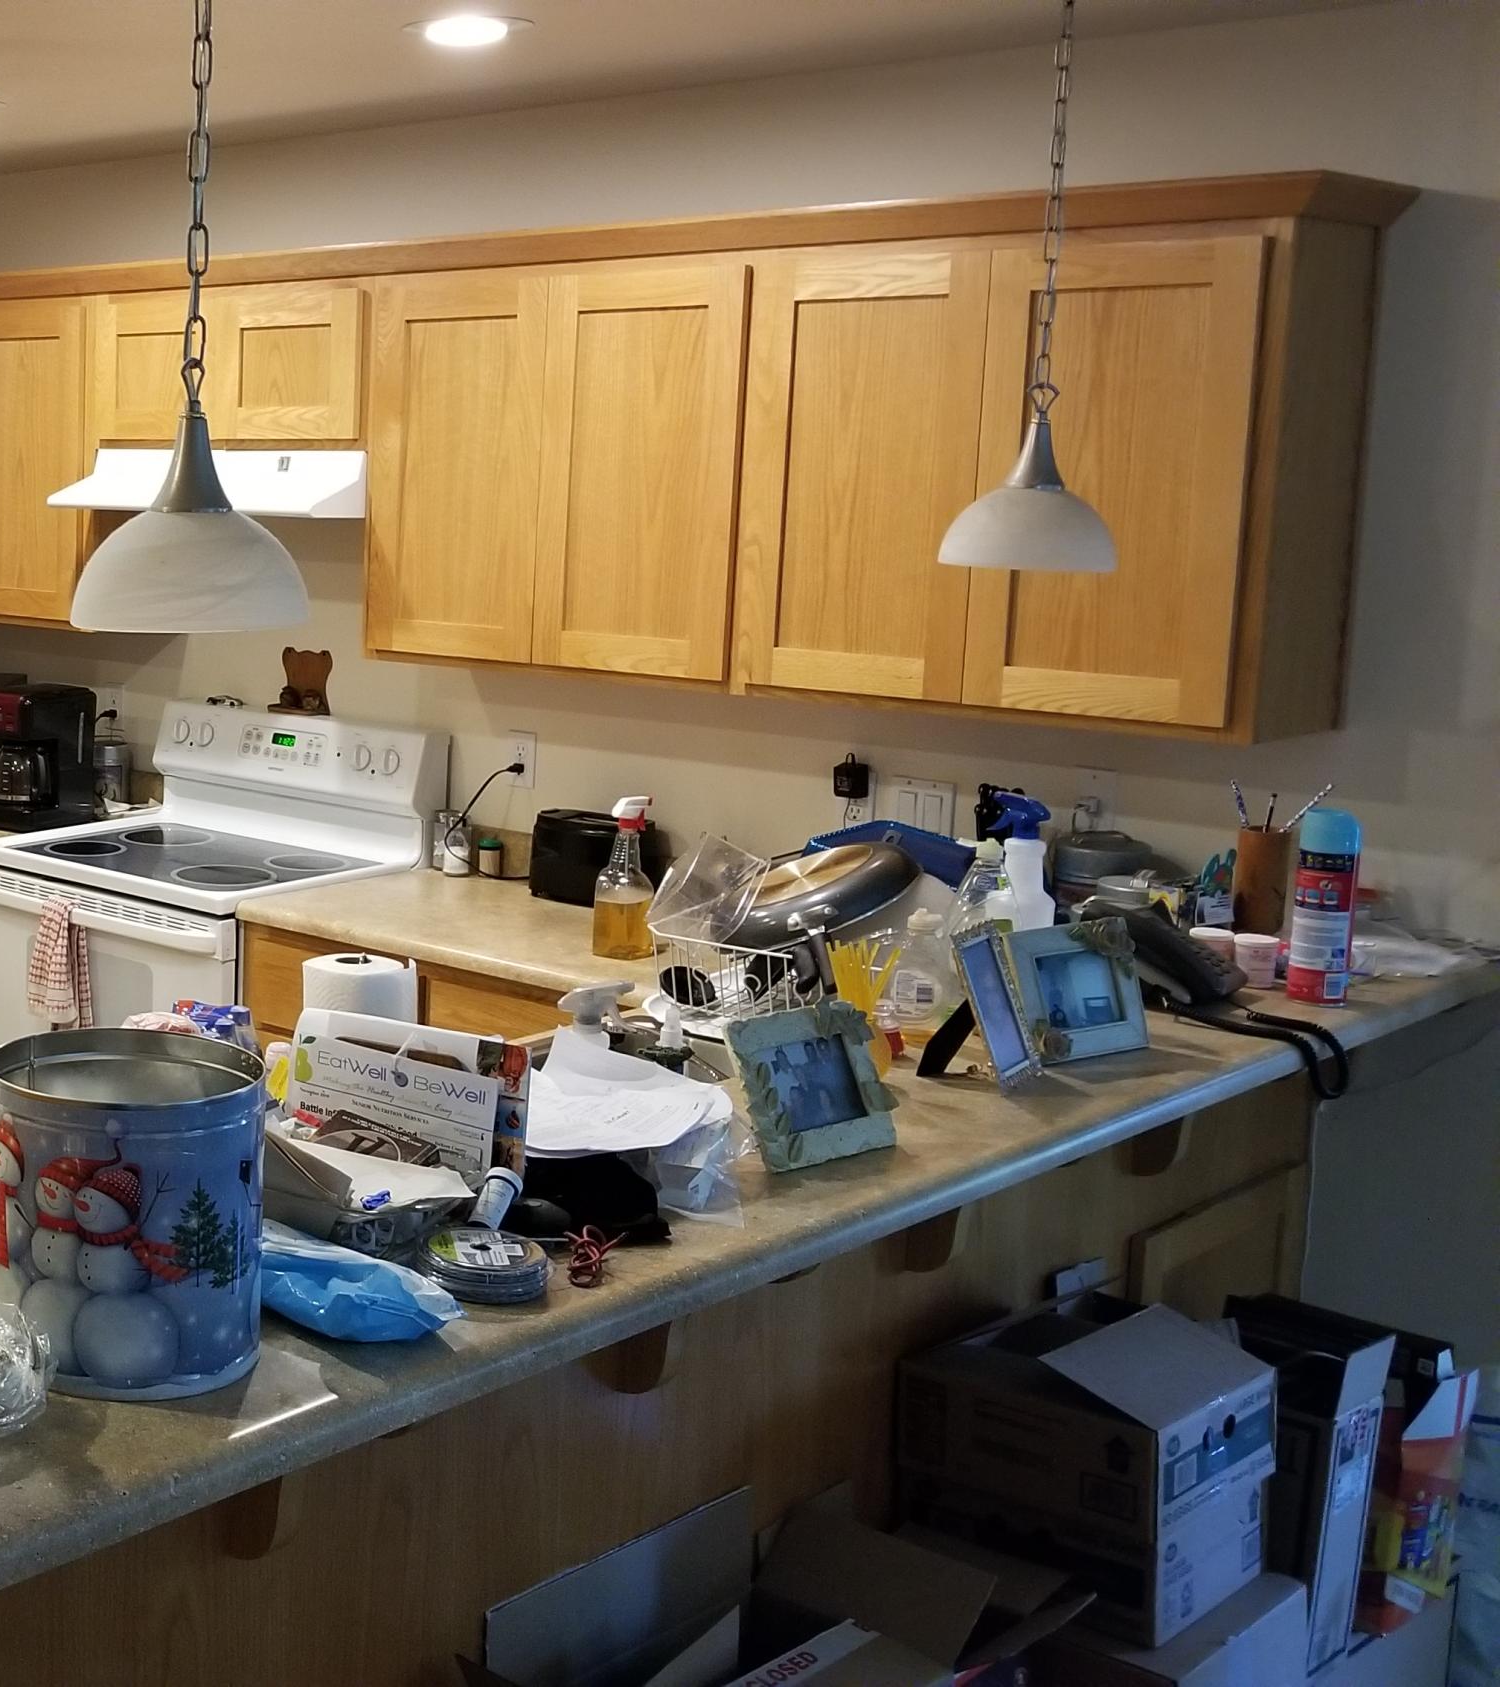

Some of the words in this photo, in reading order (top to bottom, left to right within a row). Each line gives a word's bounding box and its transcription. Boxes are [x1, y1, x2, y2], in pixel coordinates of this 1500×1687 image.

[317, 1050, 388, 1082] EatWell
[413, 1075, 486, 1106] BeWell
[299, 1100, 323, 1115] Battle
